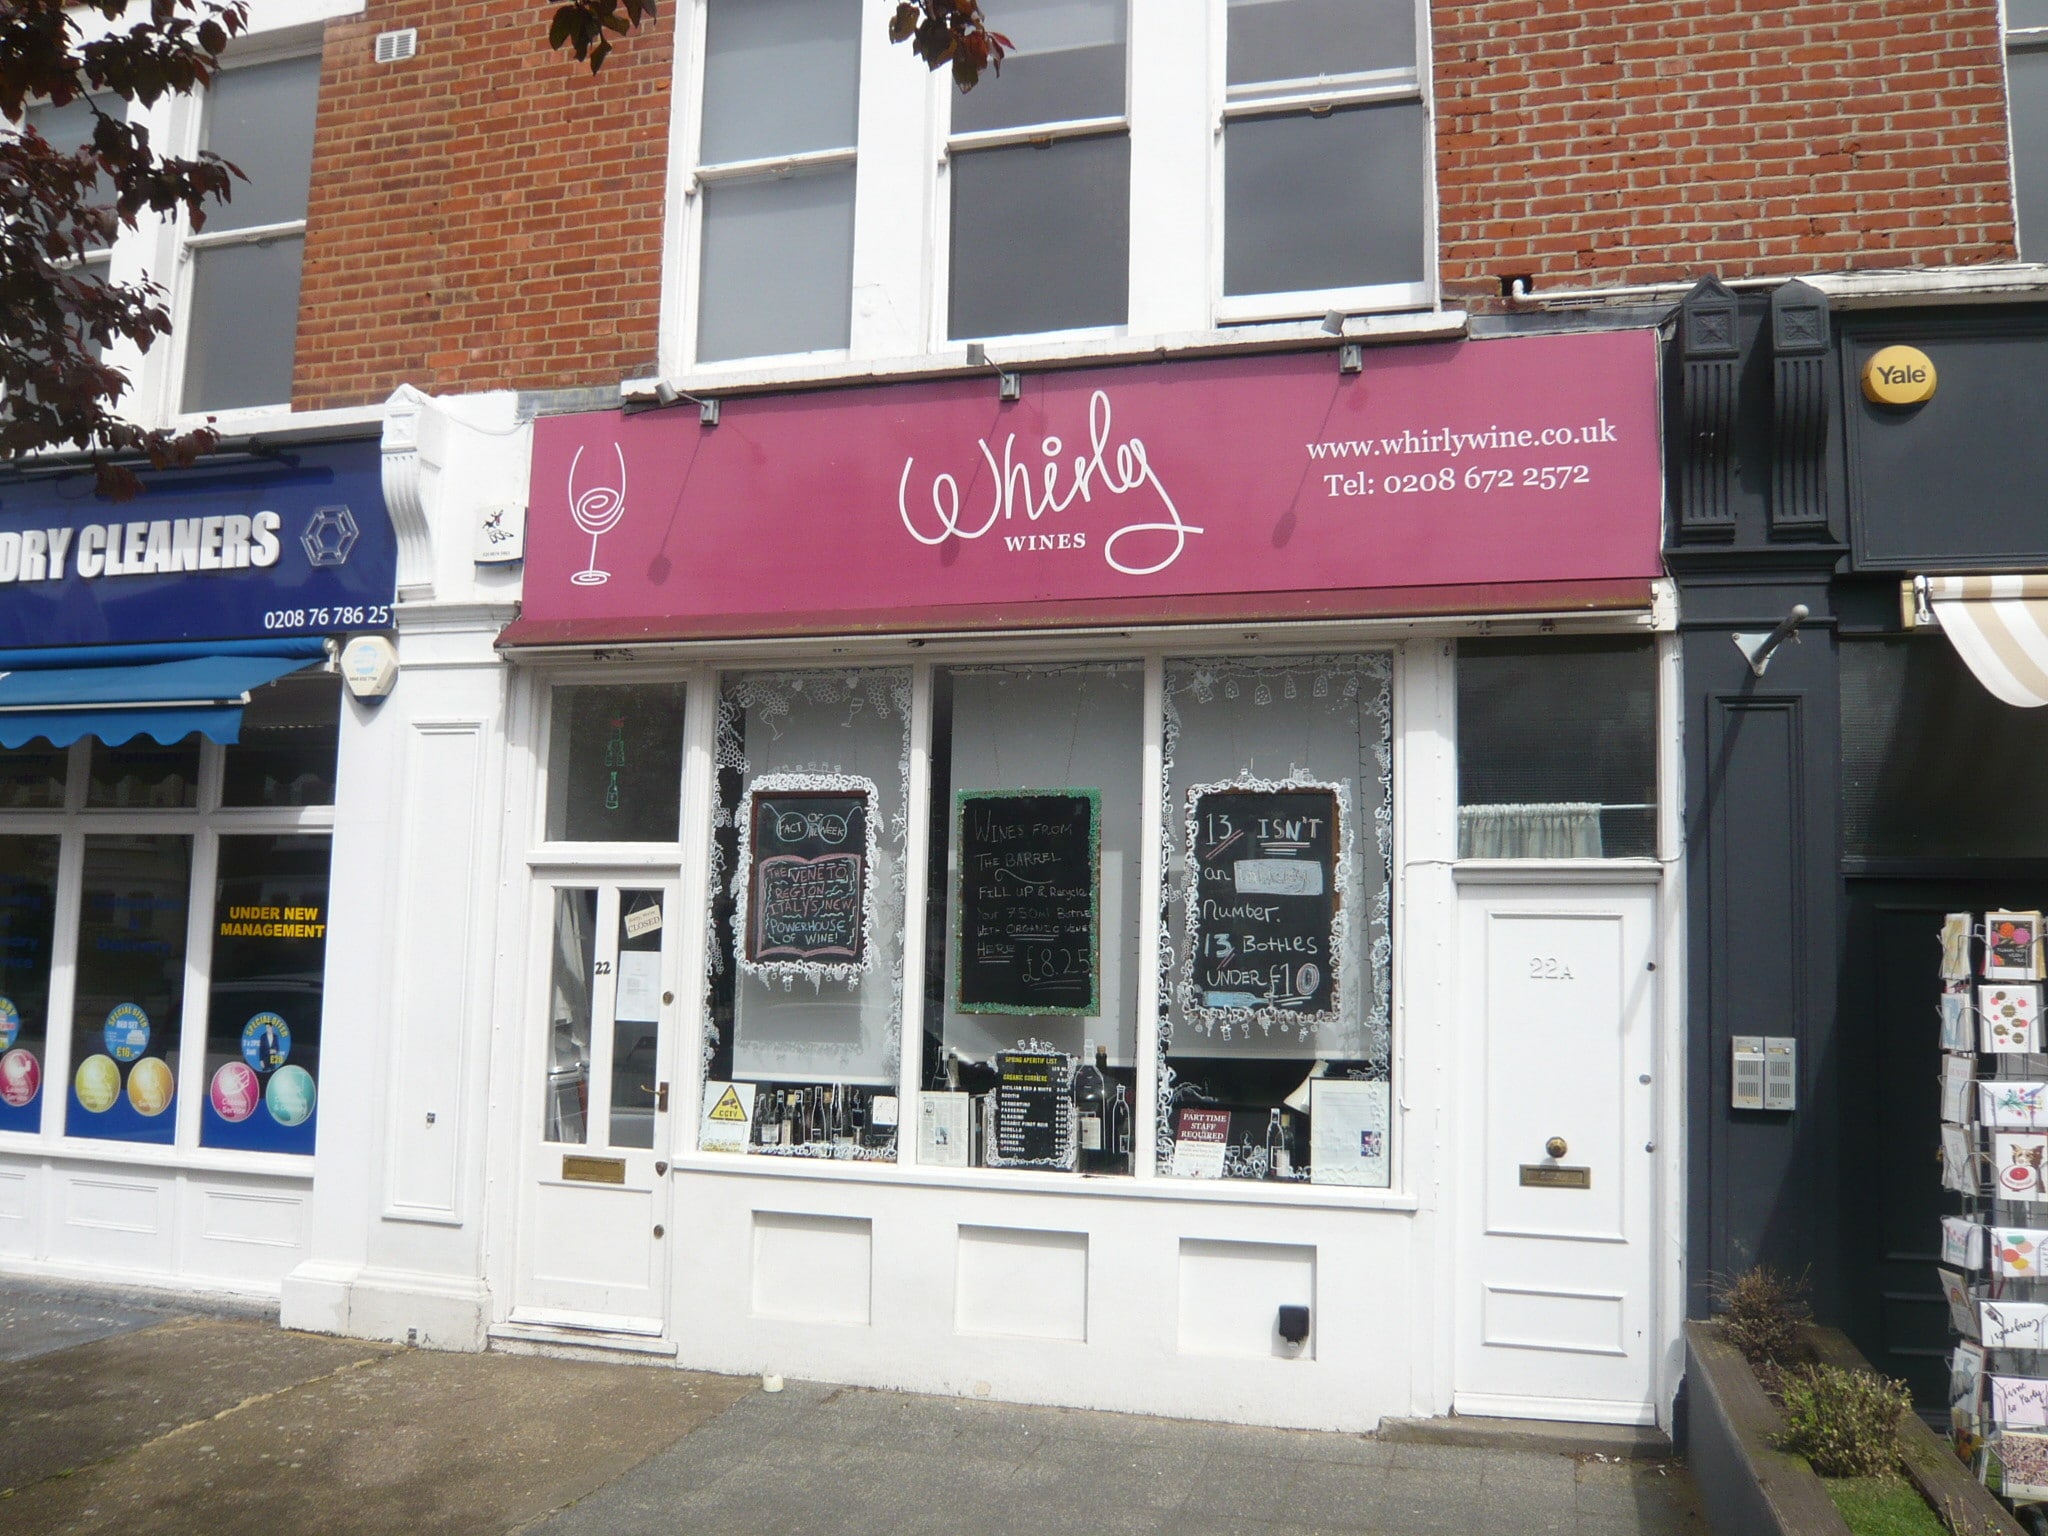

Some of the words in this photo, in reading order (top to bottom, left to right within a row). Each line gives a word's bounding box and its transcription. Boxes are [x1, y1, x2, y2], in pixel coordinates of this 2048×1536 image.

[1876, 365, 1926, 385] Yale
[1306, 418, 1618, 458] www.whirlywine.co.uk
[898, 390, 1205, 576] Whirly
[1324, 472, 1374, 497] Tel:
[1383, 467, 1456, 494] 0208
[1464, 465, 1514, 493] 672
[1522, 465, 1591, 490] 2572
[0, 527, 75, 583] DRY
[77, 510, 281, 579] CLEANERS
[1004, 532, 1087, 552] WINES
[264, 609, 305, 629] 0208
[308, 607, 329, 626] 76
[333, 605, 364, 625] 786
[367, 605, 389, 624] 25
[779, 818, 802, 836] FACT
[807, 813, 824, 823] OF
[820, 819, 844, 837] WEEK
[974, 808, 1024, 843] WINES
[1033, 823, 1073, 837] FROM
[1206, 814, 1233, 845] 13
[1257, 816, 1323, 842] ISN'T
[976, 852, 1000, 872] THE
[1005, 851, 1062, 868] BARREL
[767, 867, 787, 879] THE
[791, 866, 847, 883] VENETO
[1204, 867, 1231, 881] an
[775, 880, 825, 899] REGION
[979, 887, 1012, 900] FILL
[1016, 886, 1034, 897] UP
[1037, 886, 1047, 897] &
[229, 906, 280, 920] UNDER
[283, 907, 318, 920] NEW
[825, 899, 853, 911] NEW
[220, 922, 325, 938] MANAGEMENT
[628, 916, 660, 932] CLOSED
[770, 919, 846, 934] POWERHOUSE
[1006, 924, 1059, 934] ORGANIC
[782, 933, 796, 943] OF
[805, 932, 838, 945] WINE!
[1204, 932, 1234, 958] 13
[595, 960, 612, 975] 22
[1022, 946, 1091, 983] £8.25
[1529, 957, 1575, 980] 22A
[1207, 970, 1267, 986] UNDER
[1264, 963, 1320, 998] £10
[1183, 1113, 1204, 1121] PART
[1206, 1114, 1227, 1122] TIME
[1191, 1122, 1217, 1130] STAFF
[1181, 1130, 1224, 1140] REQUIRED
